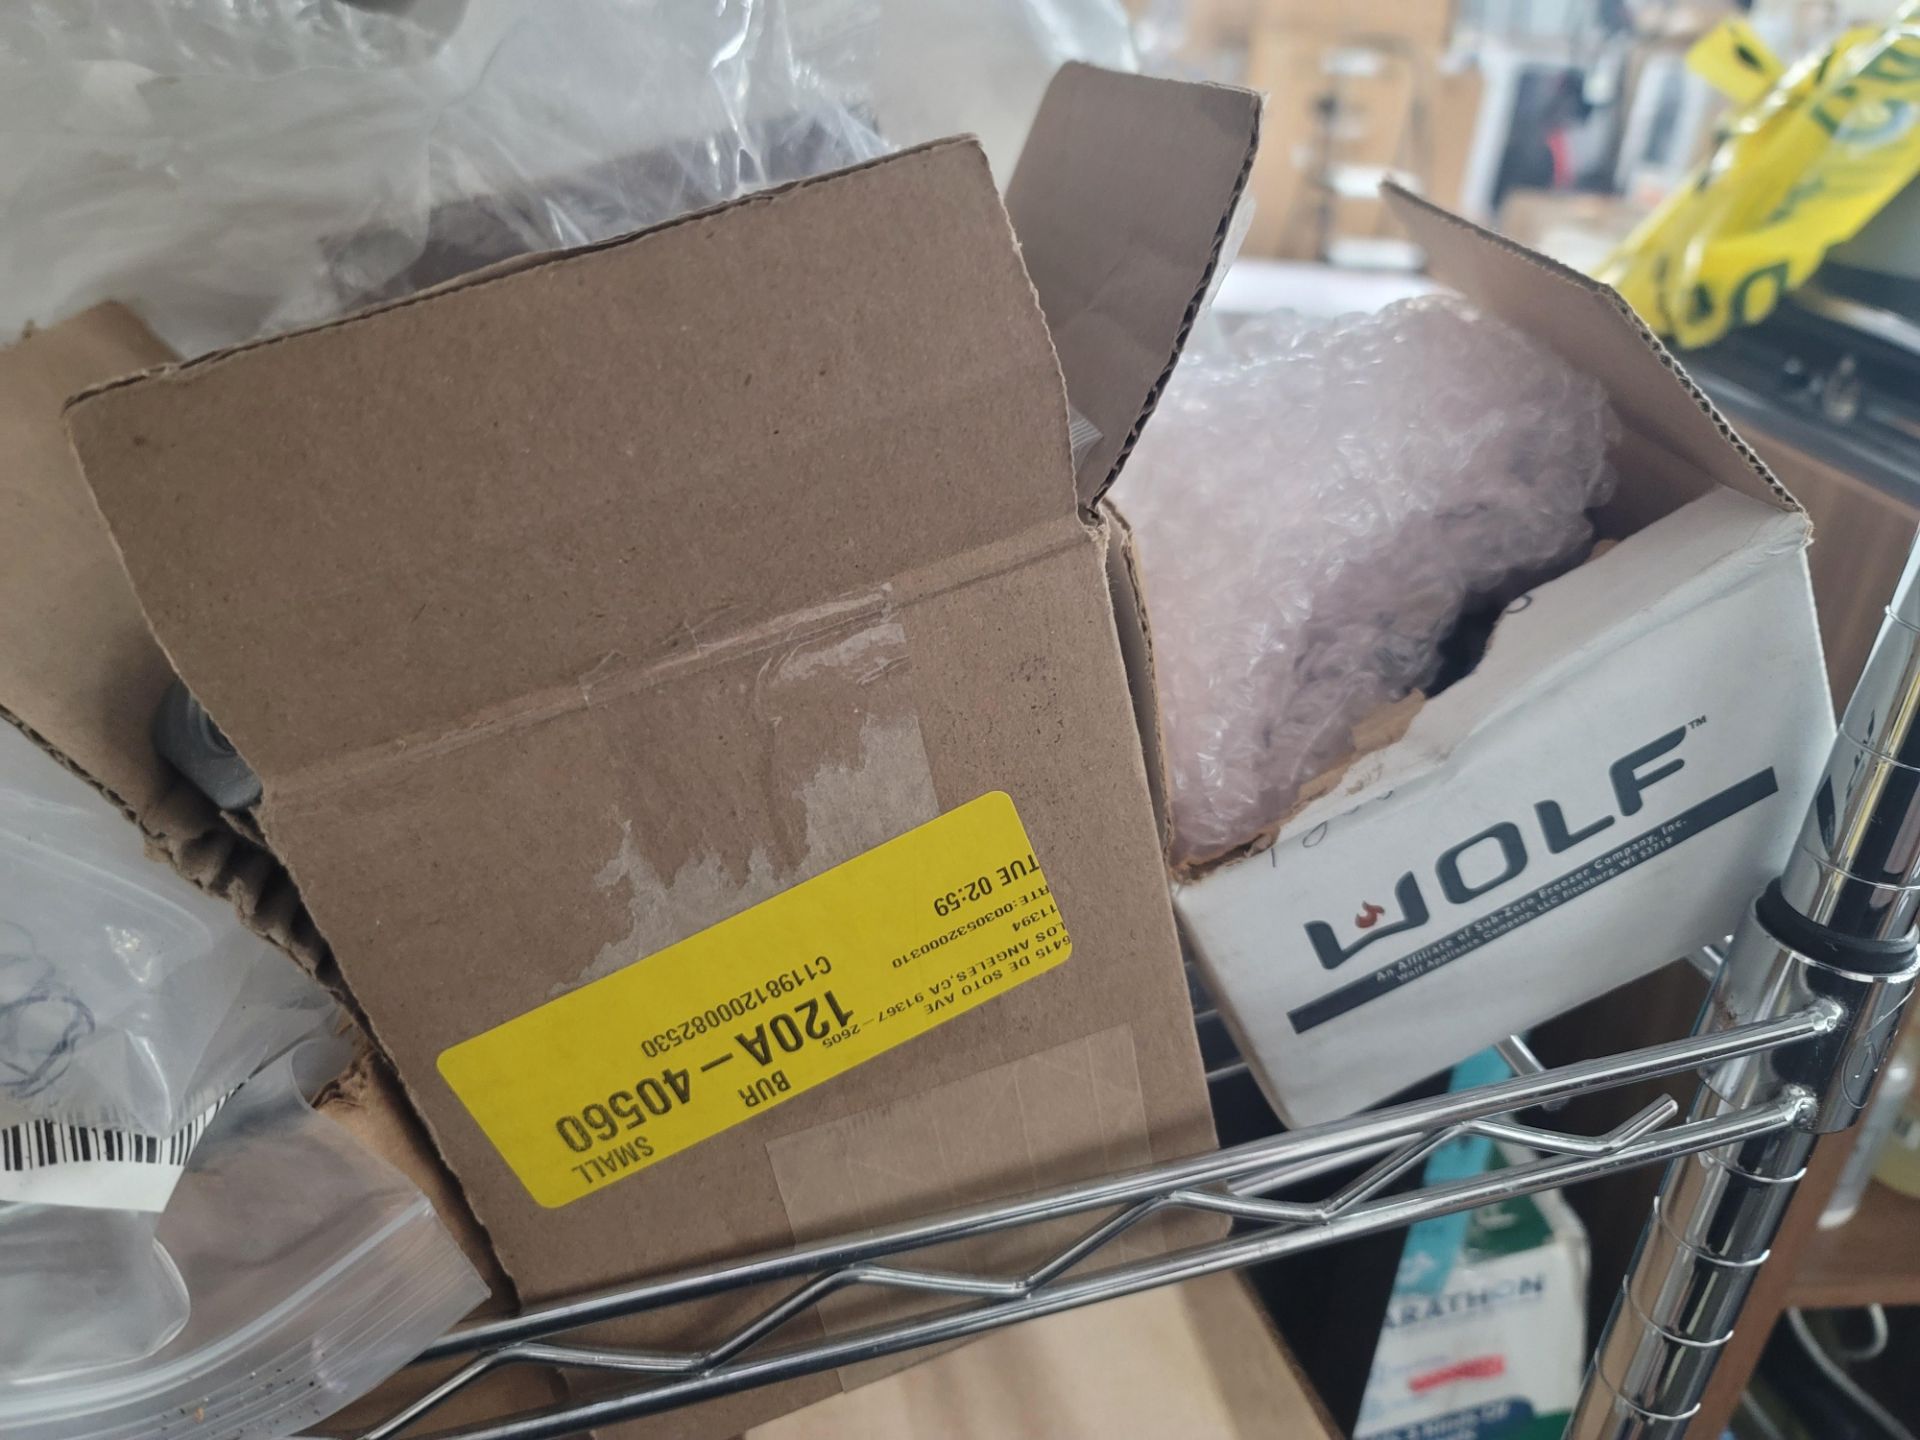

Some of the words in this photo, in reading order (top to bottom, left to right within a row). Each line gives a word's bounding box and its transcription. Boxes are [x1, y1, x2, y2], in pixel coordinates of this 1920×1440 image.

[1301, 724, 1686, 971] WOLF
[994, 852, 1038, 886] TUE
[931, 874, 994, 918] 02:59
[1010, 903, 1057, 932] 11394
[1033, 920, 1066, 944] LOS
[1034, 933, 1072, 959] 6415
[1007, 954, 1030, 972] DE
[959, 968, 1003, 996] SOTO
[639, 953, 833, 1060] C11981200082530
[922, 991, 956, 1015] AVE
[736, 1067, 792, 1110] BUR
[570, 1132, 655, 1188] SMALL
